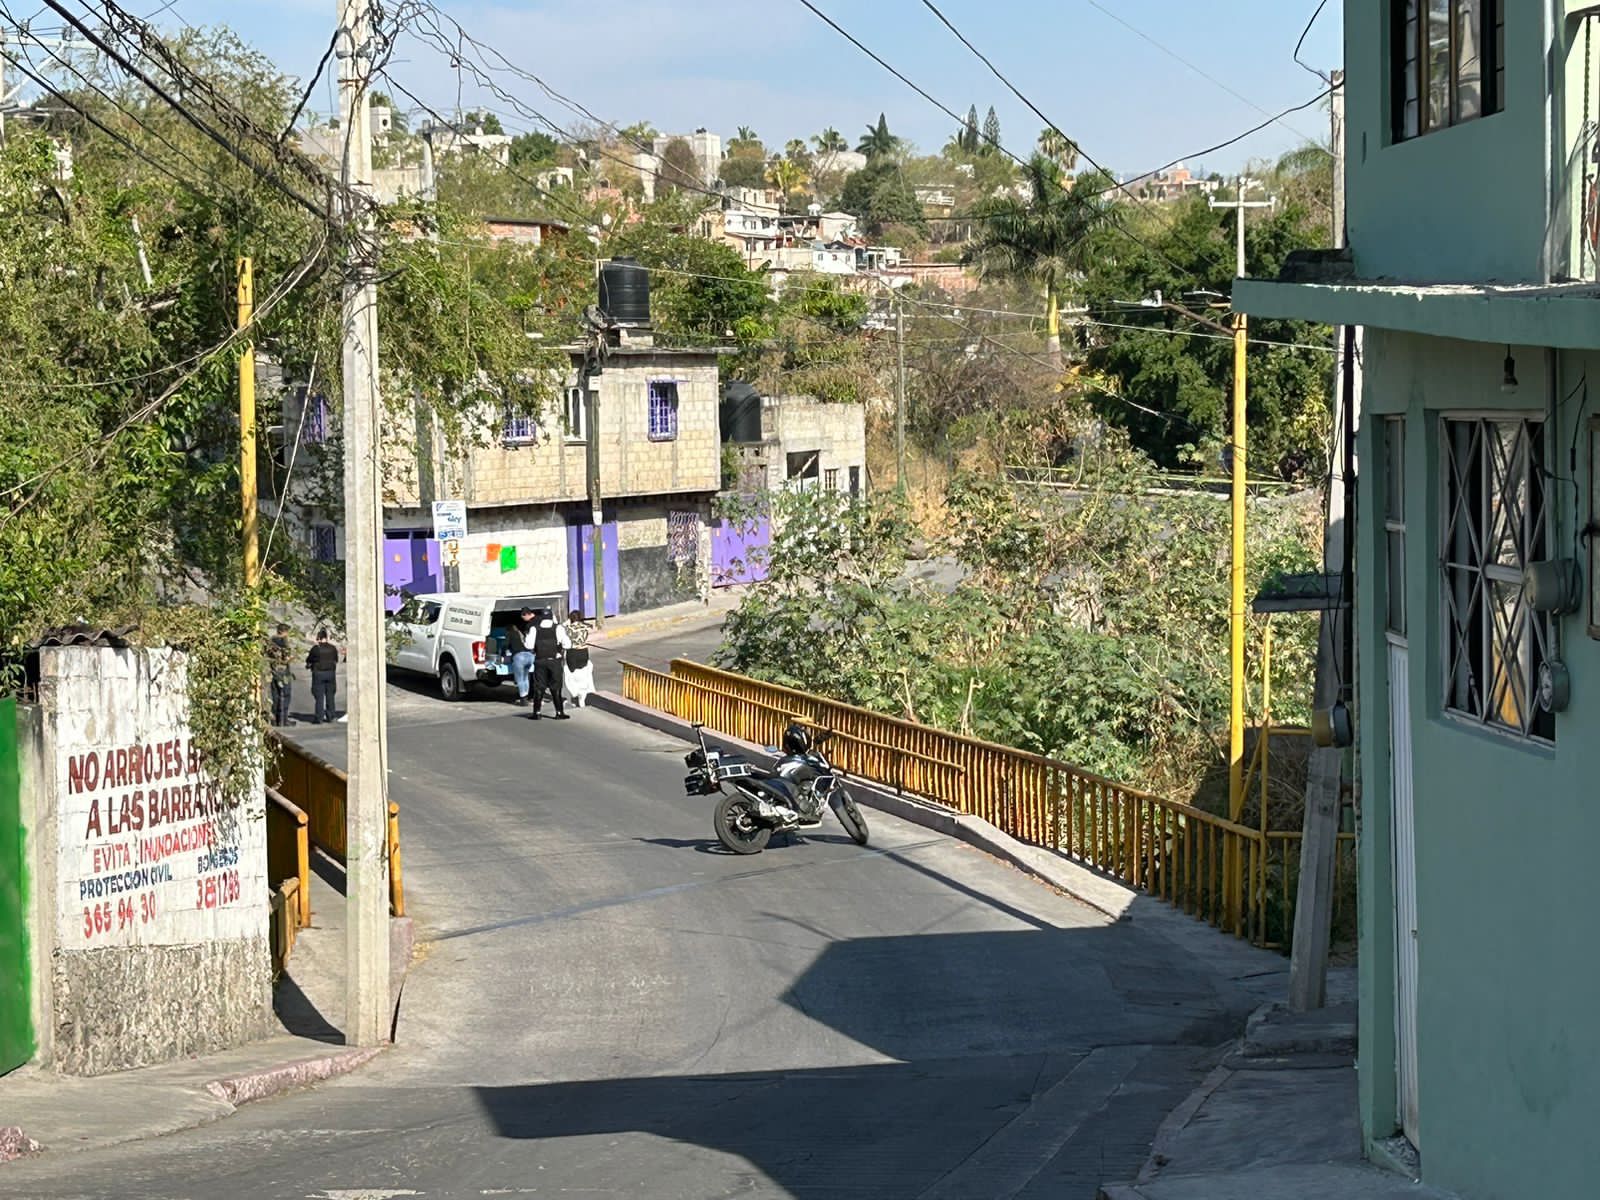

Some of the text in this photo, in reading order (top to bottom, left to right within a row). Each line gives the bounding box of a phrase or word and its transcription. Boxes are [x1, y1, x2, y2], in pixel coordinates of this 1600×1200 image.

[68, 751, 100, 795] NO
[102, 738, 183, 790] ARROJES
[85, 798, 102, 840] A
[107, 790, 144, 836] LAS
[80, 863, 173, 900] PROTECCION CIVIL
[93, 842, 131, 873] EVITA
[83, 890, 156, 939] 365 94 30
